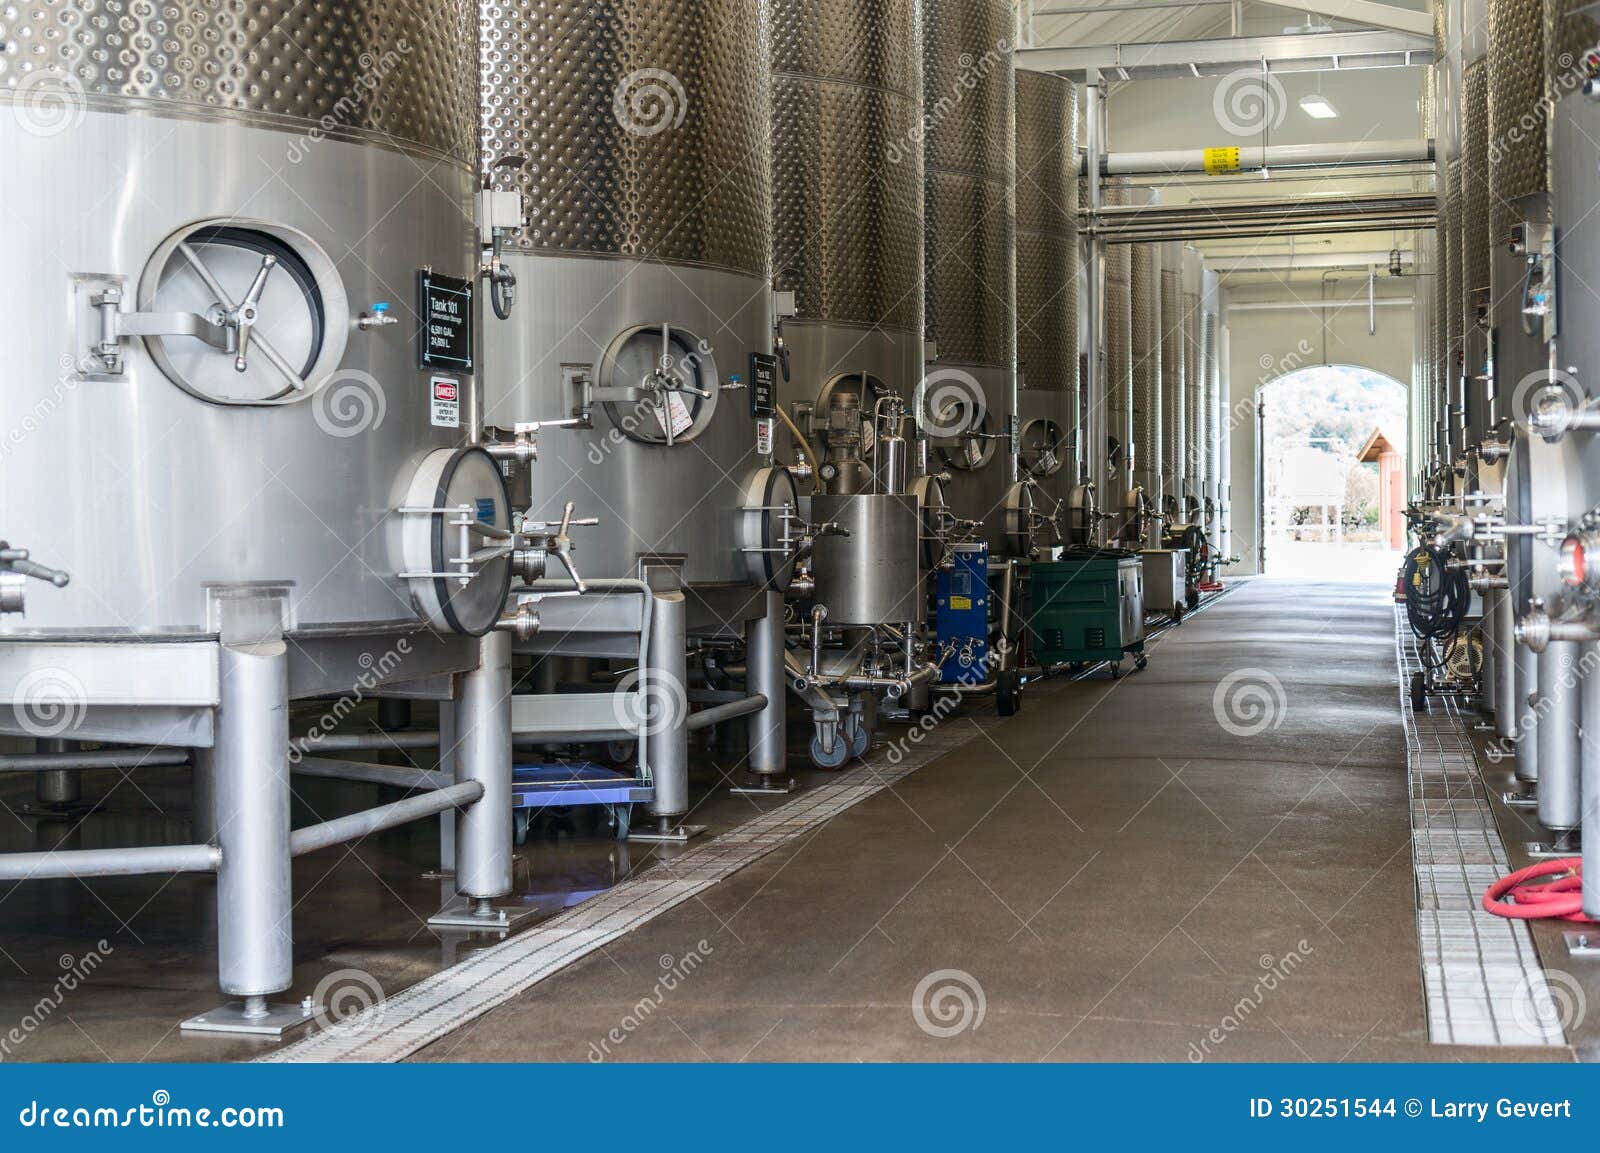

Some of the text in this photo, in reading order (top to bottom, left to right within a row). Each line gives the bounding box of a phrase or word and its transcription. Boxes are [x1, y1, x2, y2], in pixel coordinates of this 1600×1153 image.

[431, 297, 458, 314] Tank 101
[435, 386, 456, 397] DANGER
